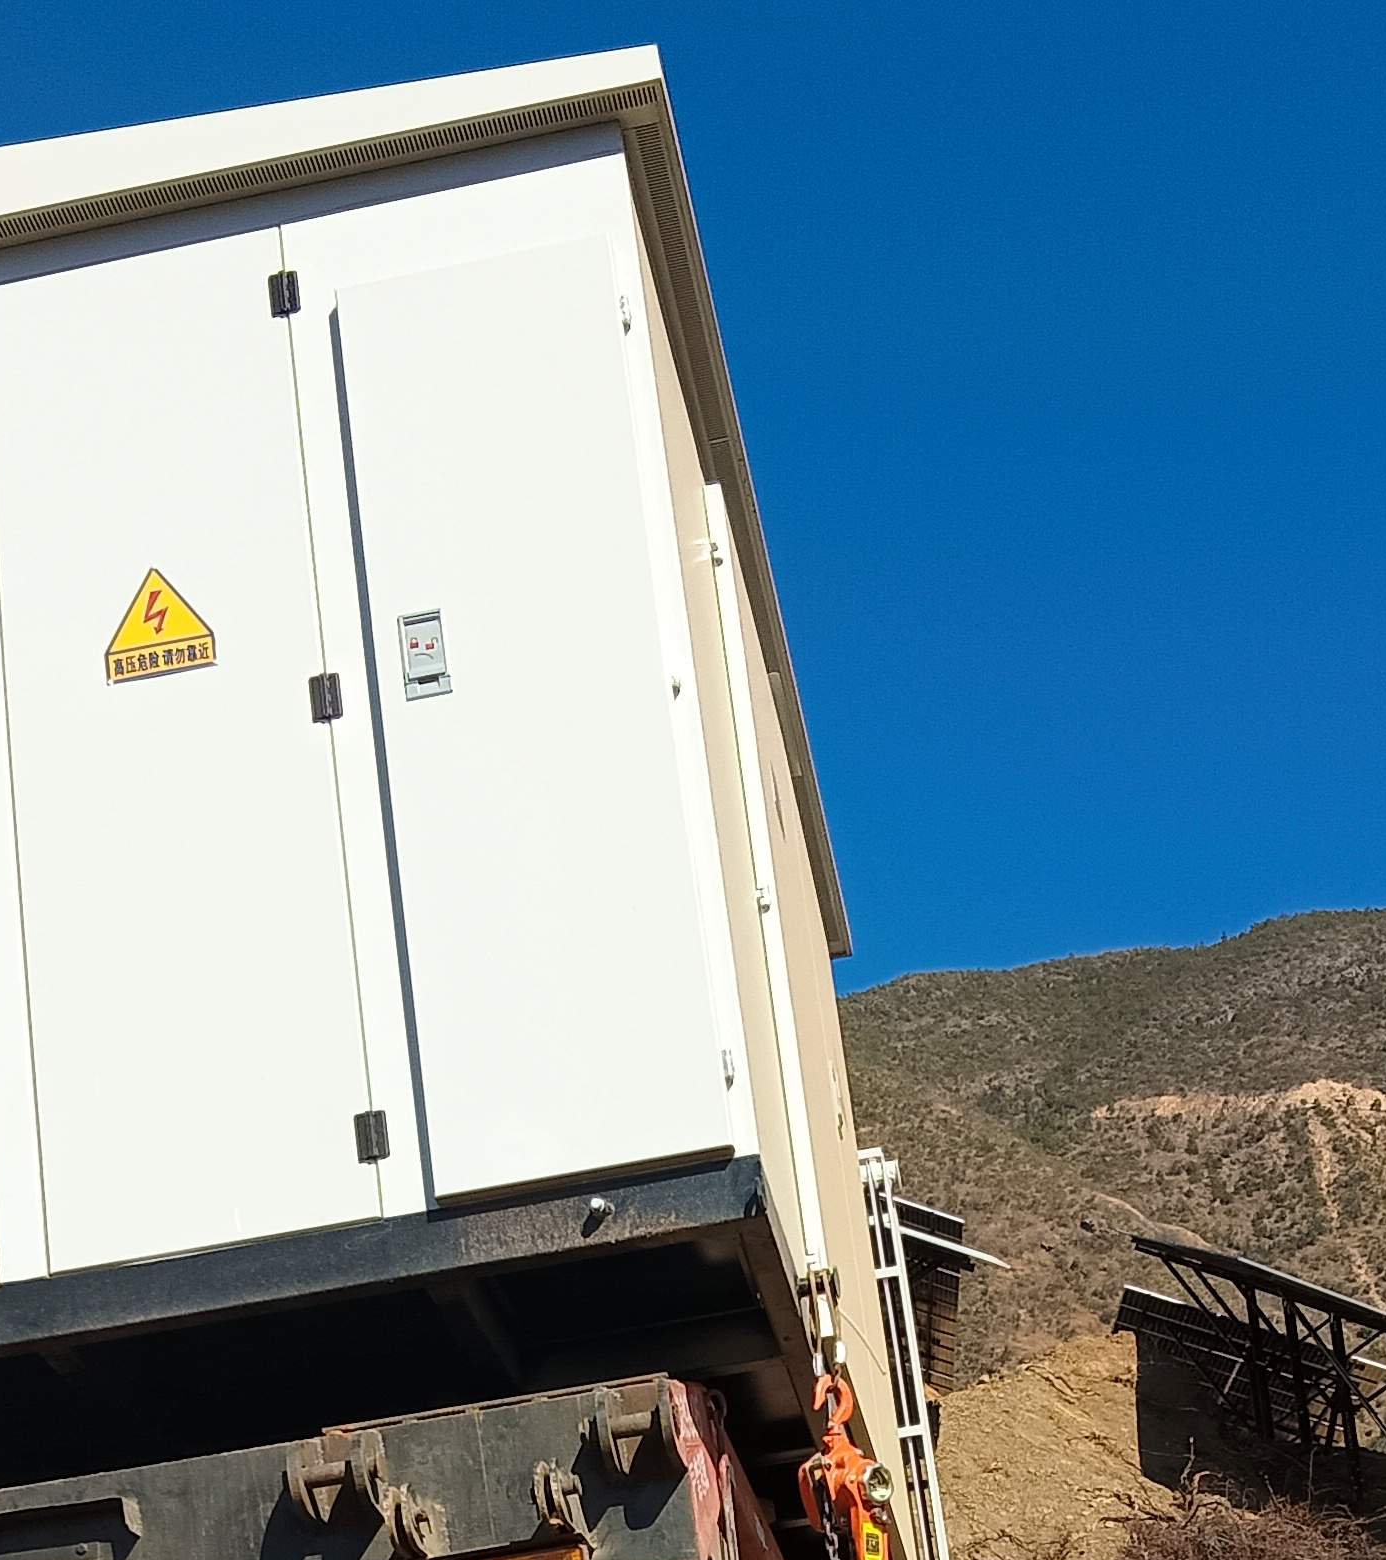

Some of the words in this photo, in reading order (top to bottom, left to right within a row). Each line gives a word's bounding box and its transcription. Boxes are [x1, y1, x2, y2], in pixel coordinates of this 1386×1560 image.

[114, 651, 160, 677] 高压危险
[162, 642, 209, 666] 请勿靠近
